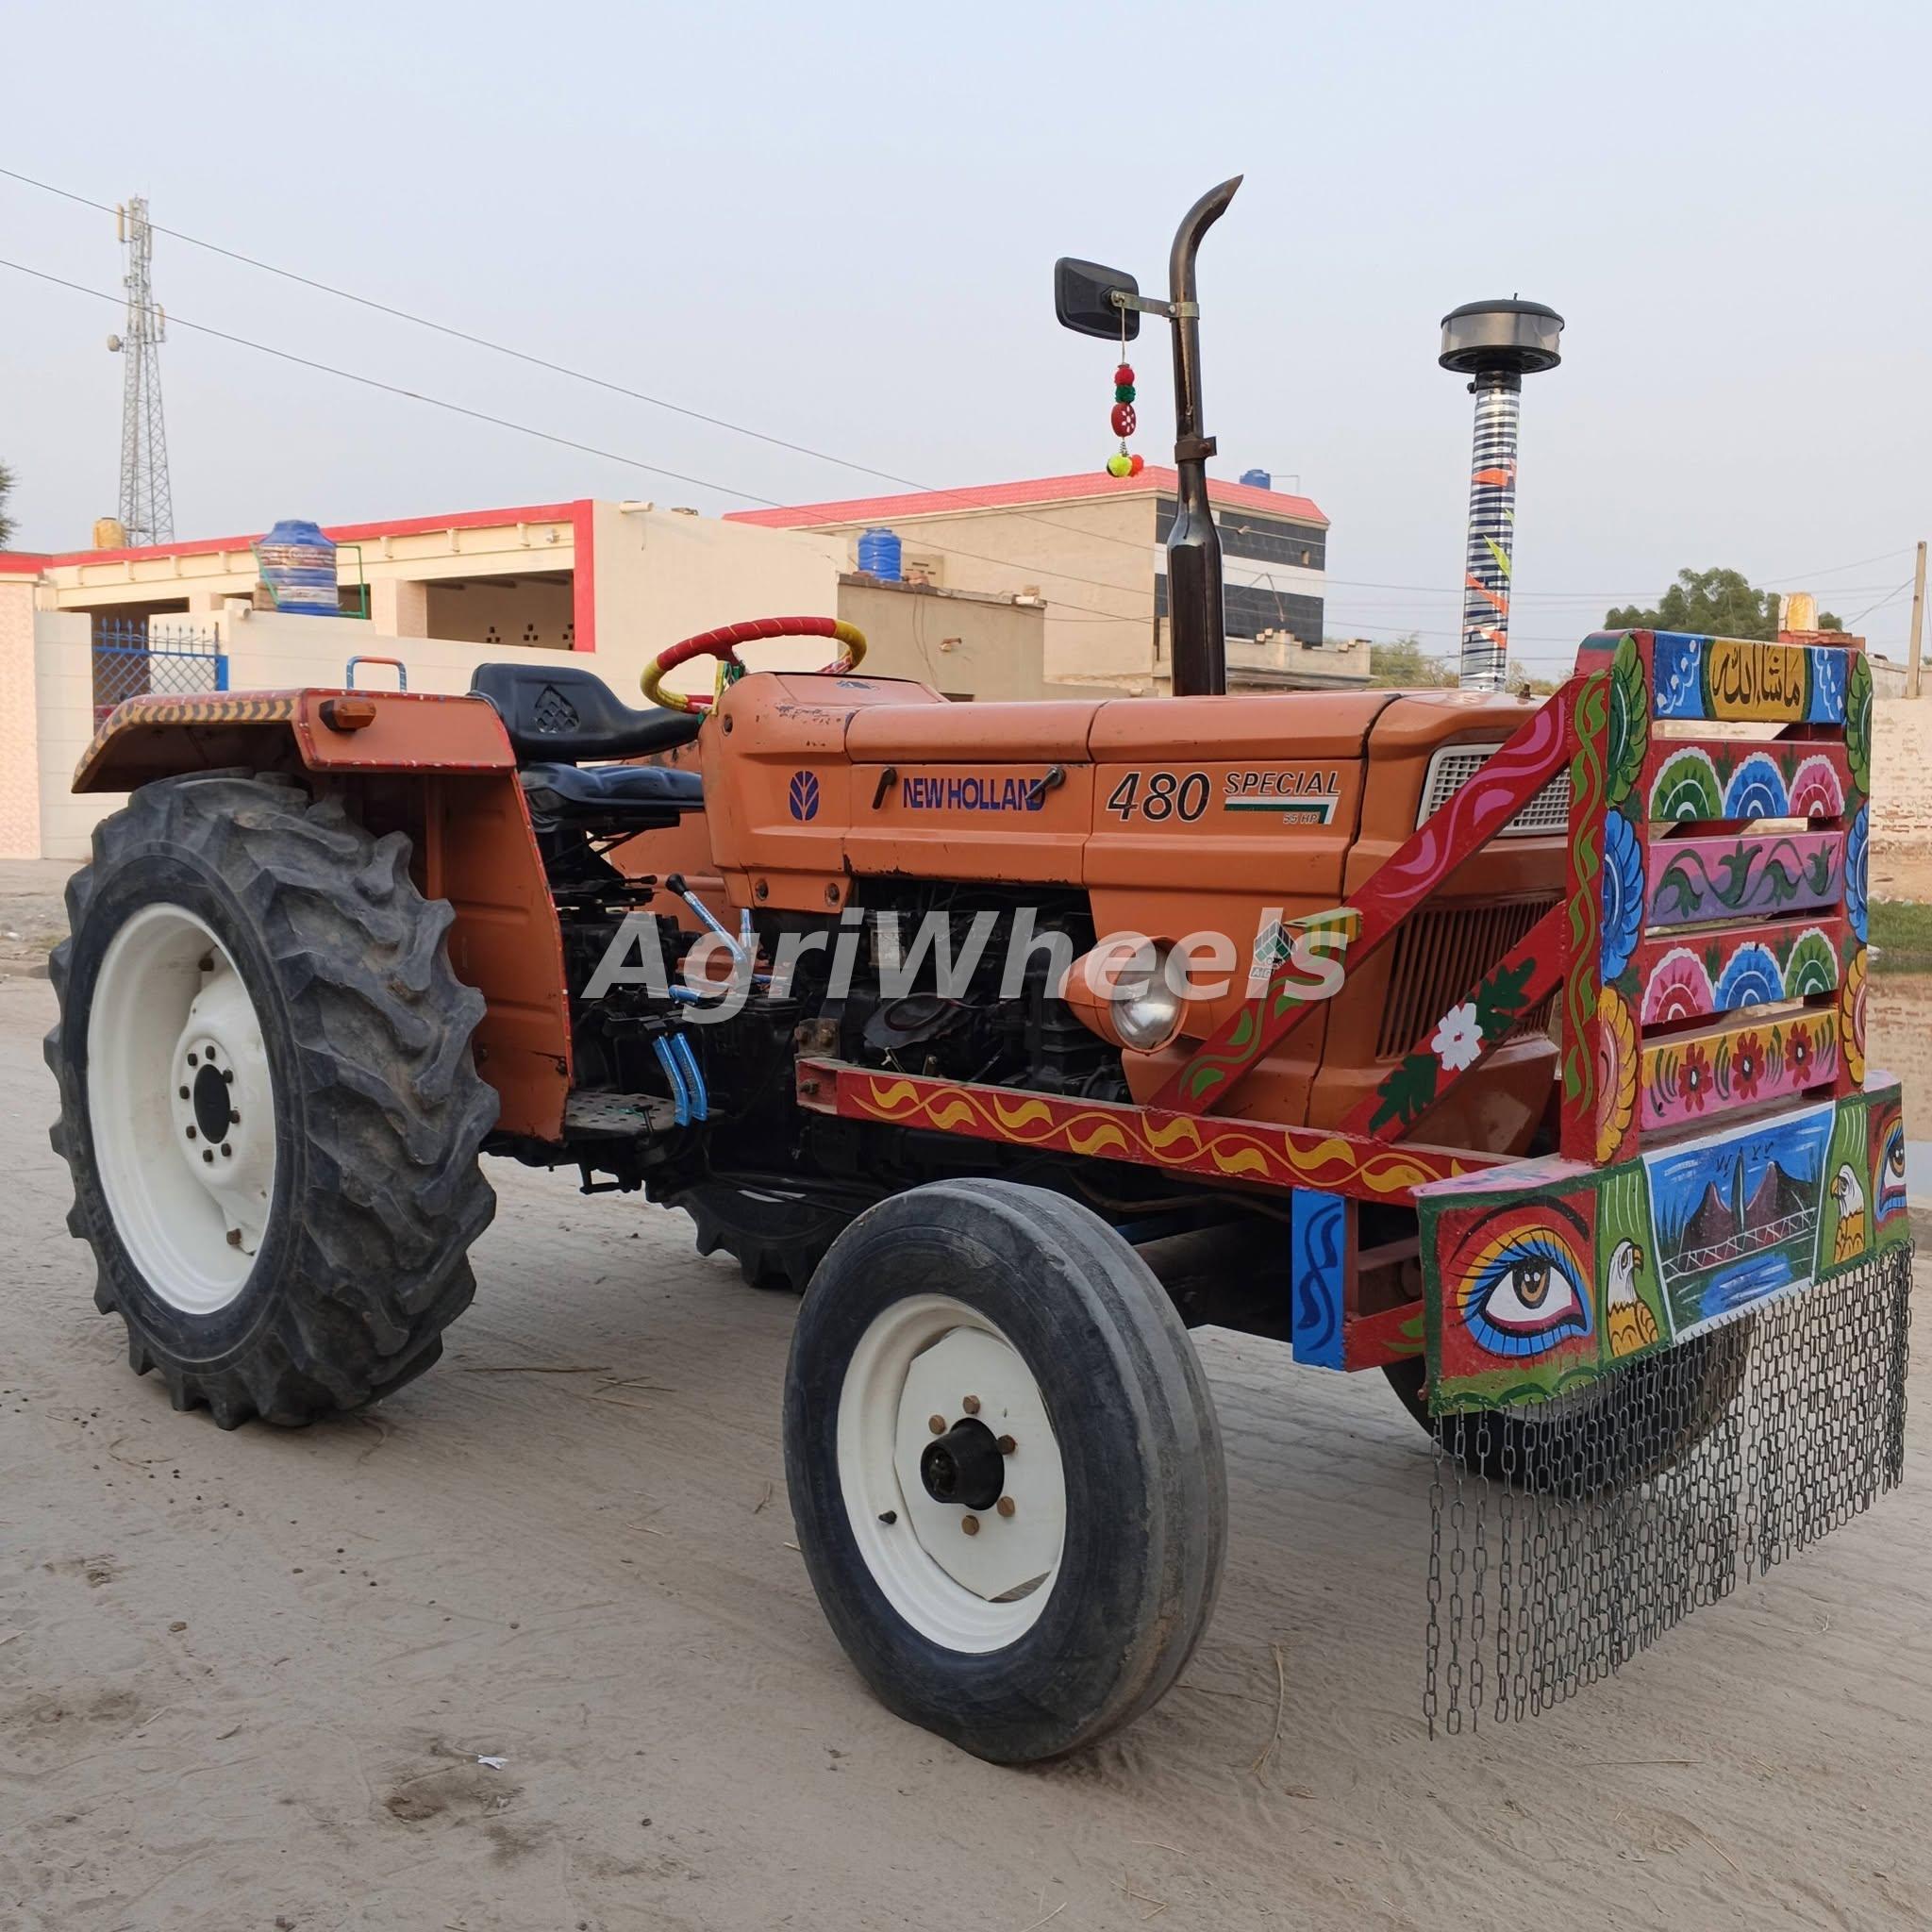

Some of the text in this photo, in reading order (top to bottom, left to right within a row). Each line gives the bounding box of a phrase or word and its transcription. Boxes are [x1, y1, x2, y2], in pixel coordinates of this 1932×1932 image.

[903, 777, 1046, 811] NEW HOLLAND
[1106, 772, 1211, 823] 480
[1223, 771, 1341, 796] SPECIAL
[1283, 812, 1319, 824] 55 HP
